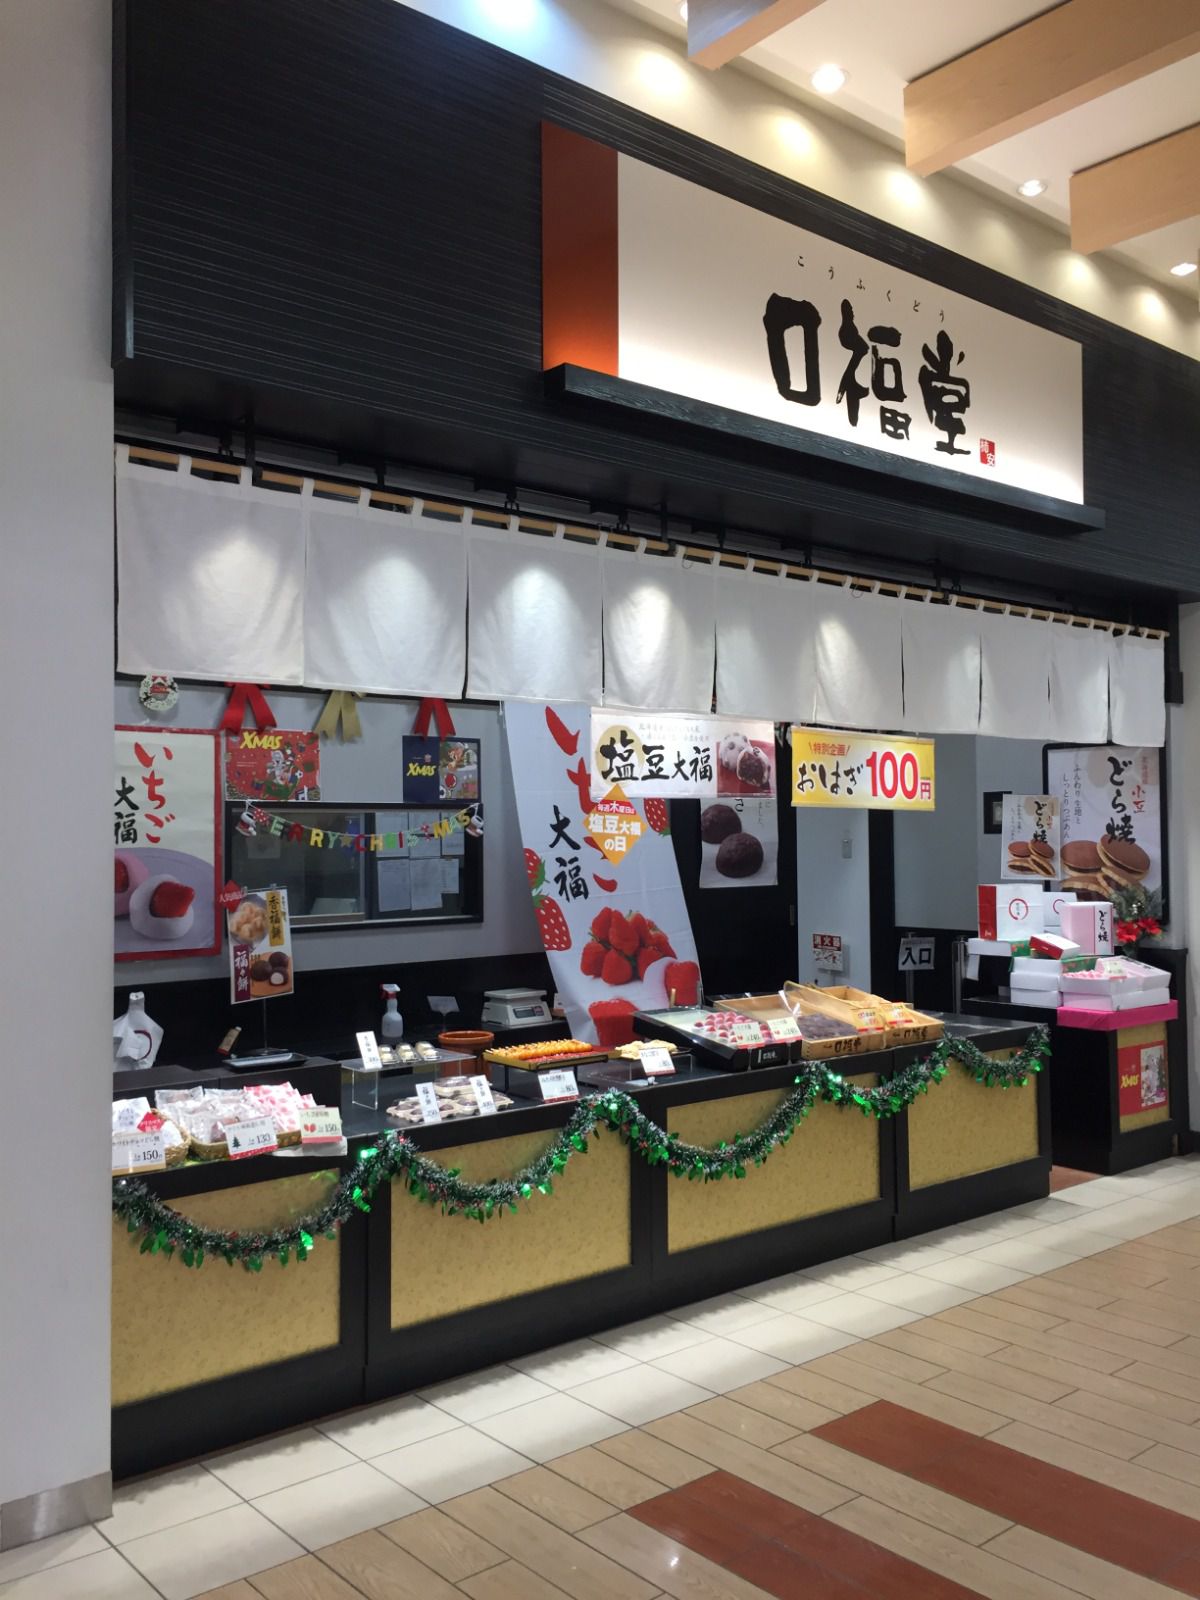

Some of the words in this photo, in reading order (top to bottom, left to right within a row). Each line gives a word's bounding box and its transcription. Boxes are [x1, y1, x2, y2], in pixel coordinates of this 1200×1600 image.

[797, 255, 945, 323] こうふくどう
[763, 292, 971, 455] 口福堂
[240, 731, 283, 749] XMAS
[600, 730, 712, 782] 塩豆大福
[133, 742, 175, 843] いちご
[797, 760, 863, 795] おはぎ
[1132, 785, 1145, 813] 小豆
[114, 776, 140, 845] 大福
[1106, 756, 1136, 844] どら焼
[588, 813, 642, 836] 塩豆大福
[604, 836, 626, 852] の日
[1033, 801, 1048, 844] どら焼
[549, 805, 590, 901] 大福
[1098, 910, 1109, 942] どら焼
[901, 947, 932, 966] 入口
